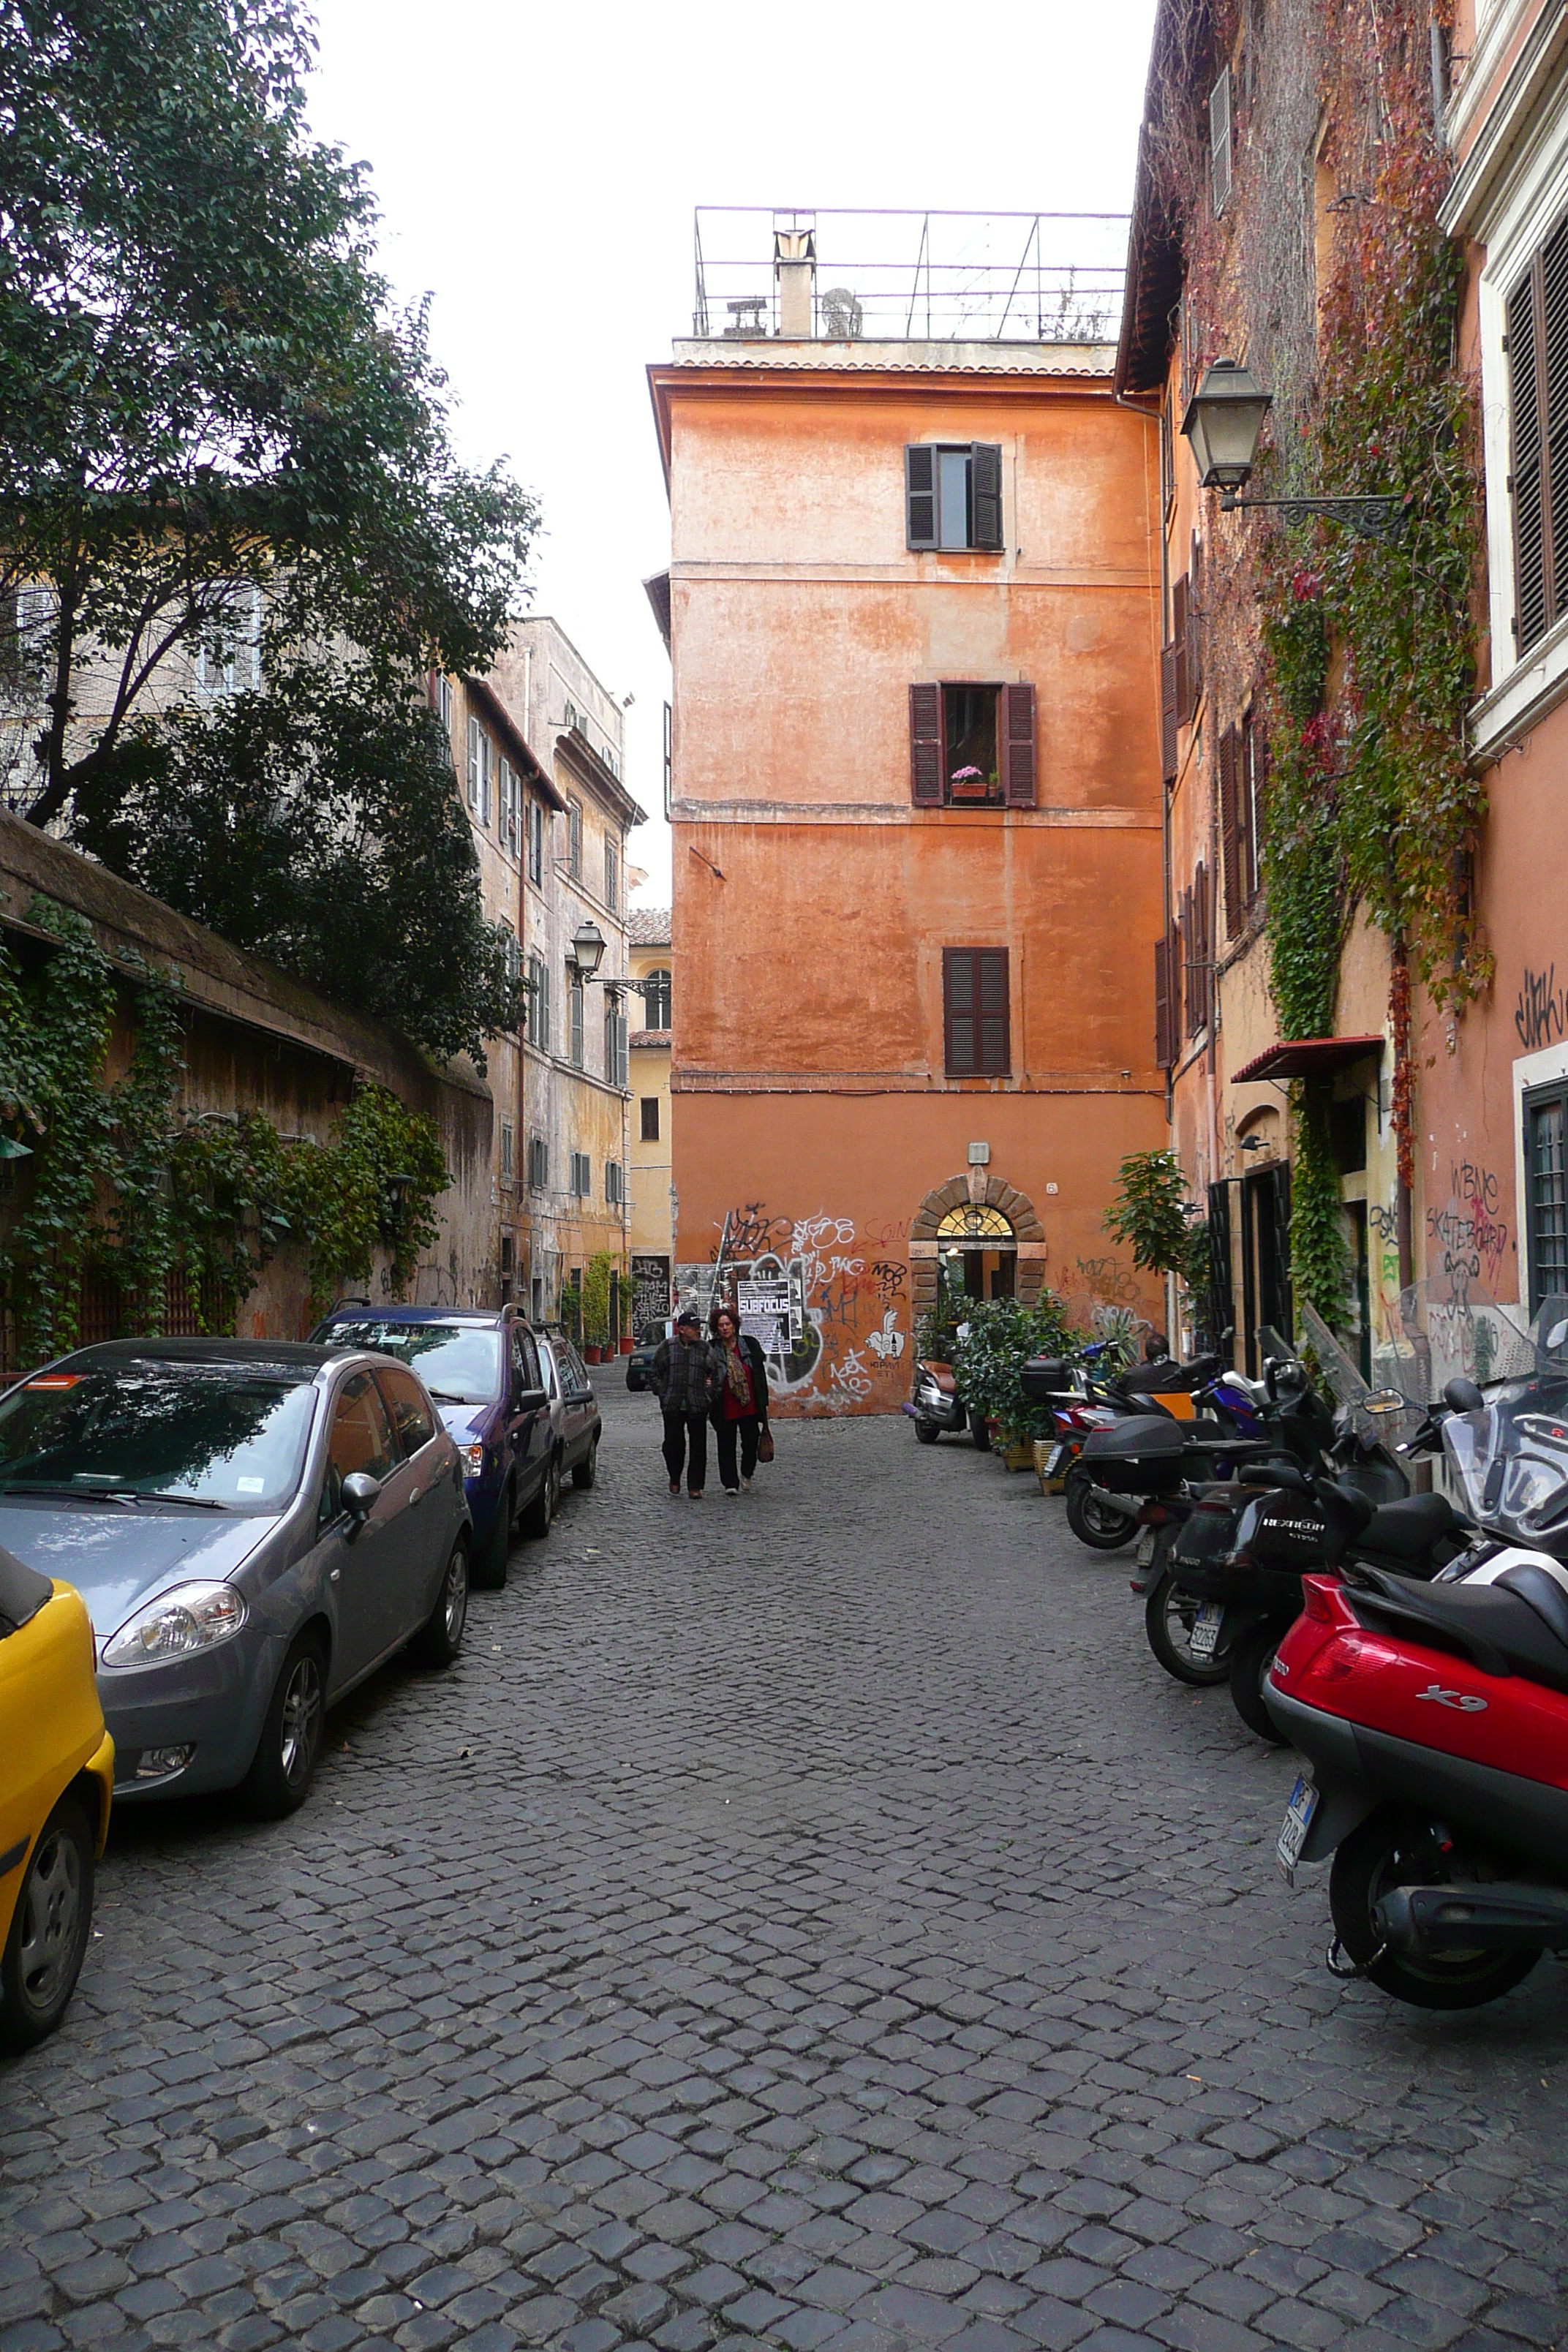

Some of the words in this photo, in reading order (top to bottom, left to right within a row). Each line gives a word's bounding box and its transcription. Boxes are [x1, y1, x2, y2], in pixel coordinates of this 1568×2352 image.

[1048, 1183, 1055, 1193] 6
[740, 1298, 789, 1313] SUBFOCUS
[1415, 1684, 1488, 1712] X9
